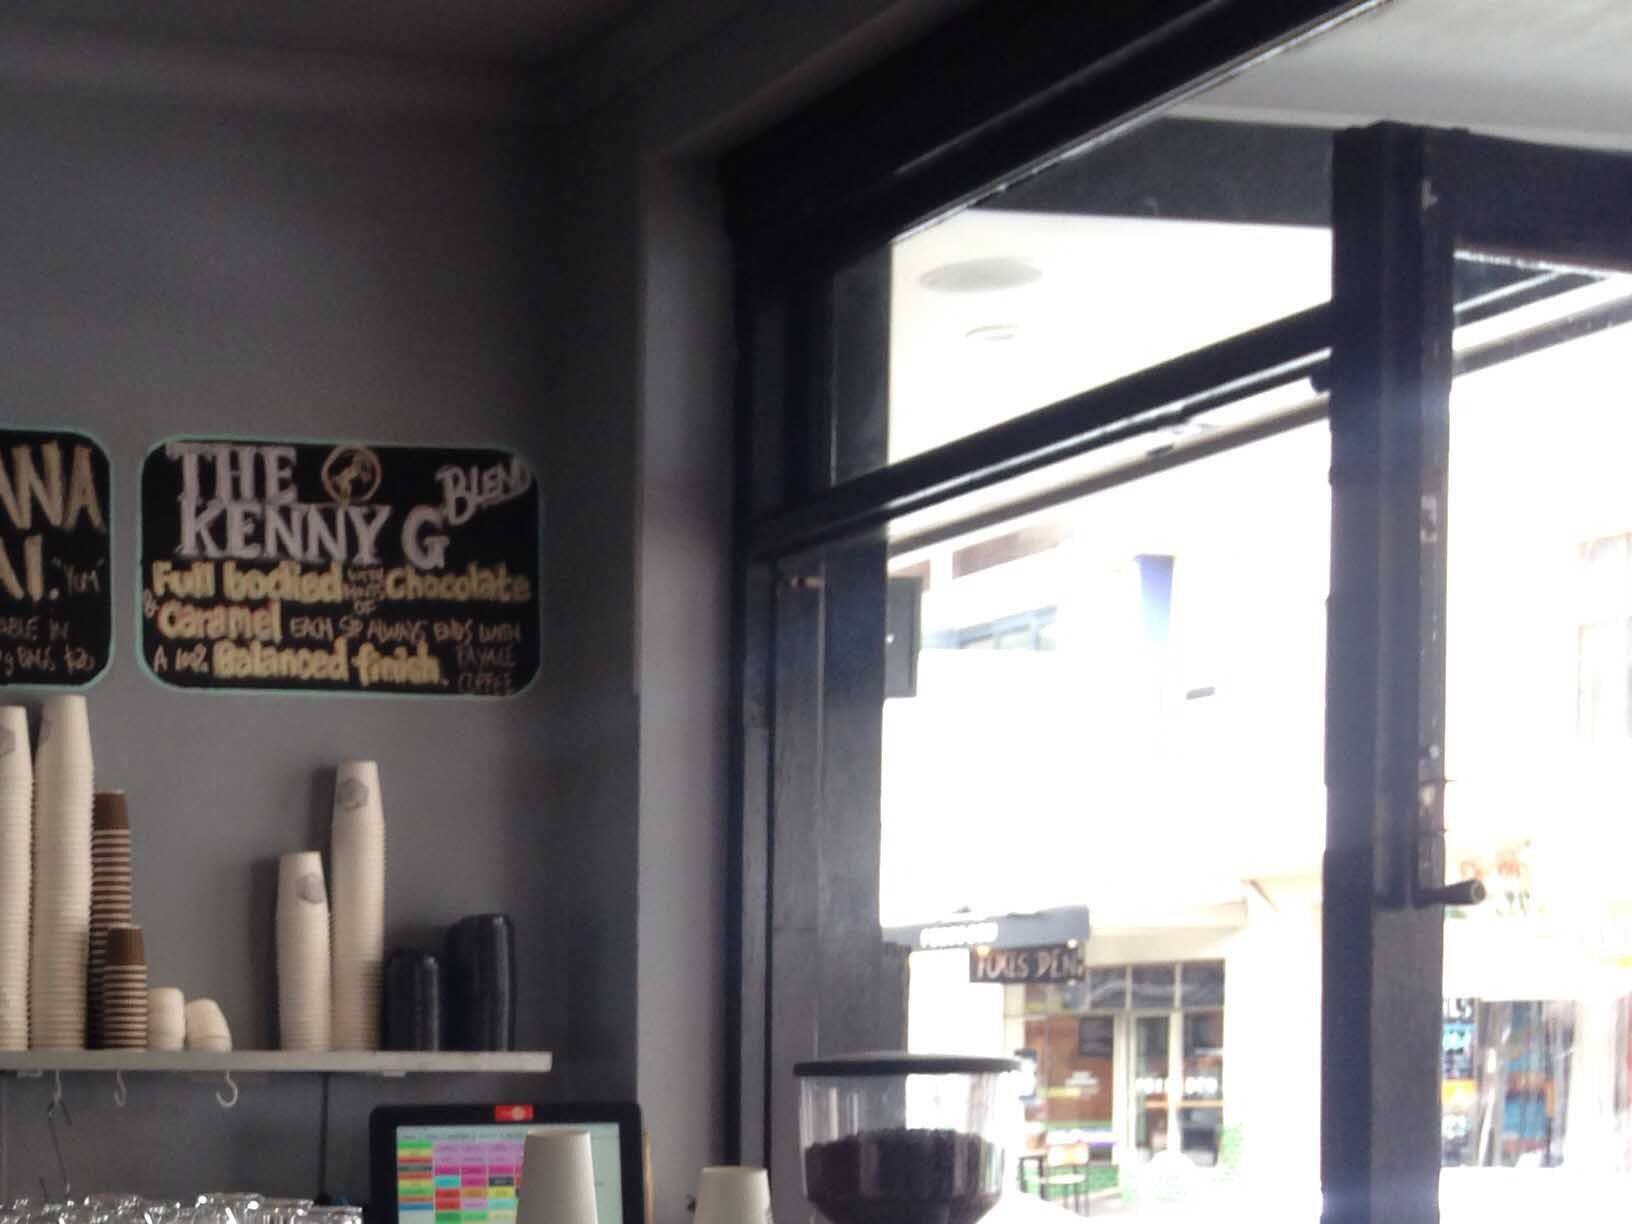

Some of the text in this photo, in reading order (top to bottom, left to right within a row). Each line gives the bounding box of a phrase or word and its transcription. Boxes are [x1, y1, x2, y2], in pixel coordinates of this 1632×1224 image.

[165, 443, 297, 502] THE
[175, 501, 391, 564] KENNY
[401, 505, 450, 570] G
[152, 560, 215, 598] Full
[222, 559, 344, 602] bodied
[385, 560, 531, 603] Chocolate
[212, 637, 350, 684] Balanced
